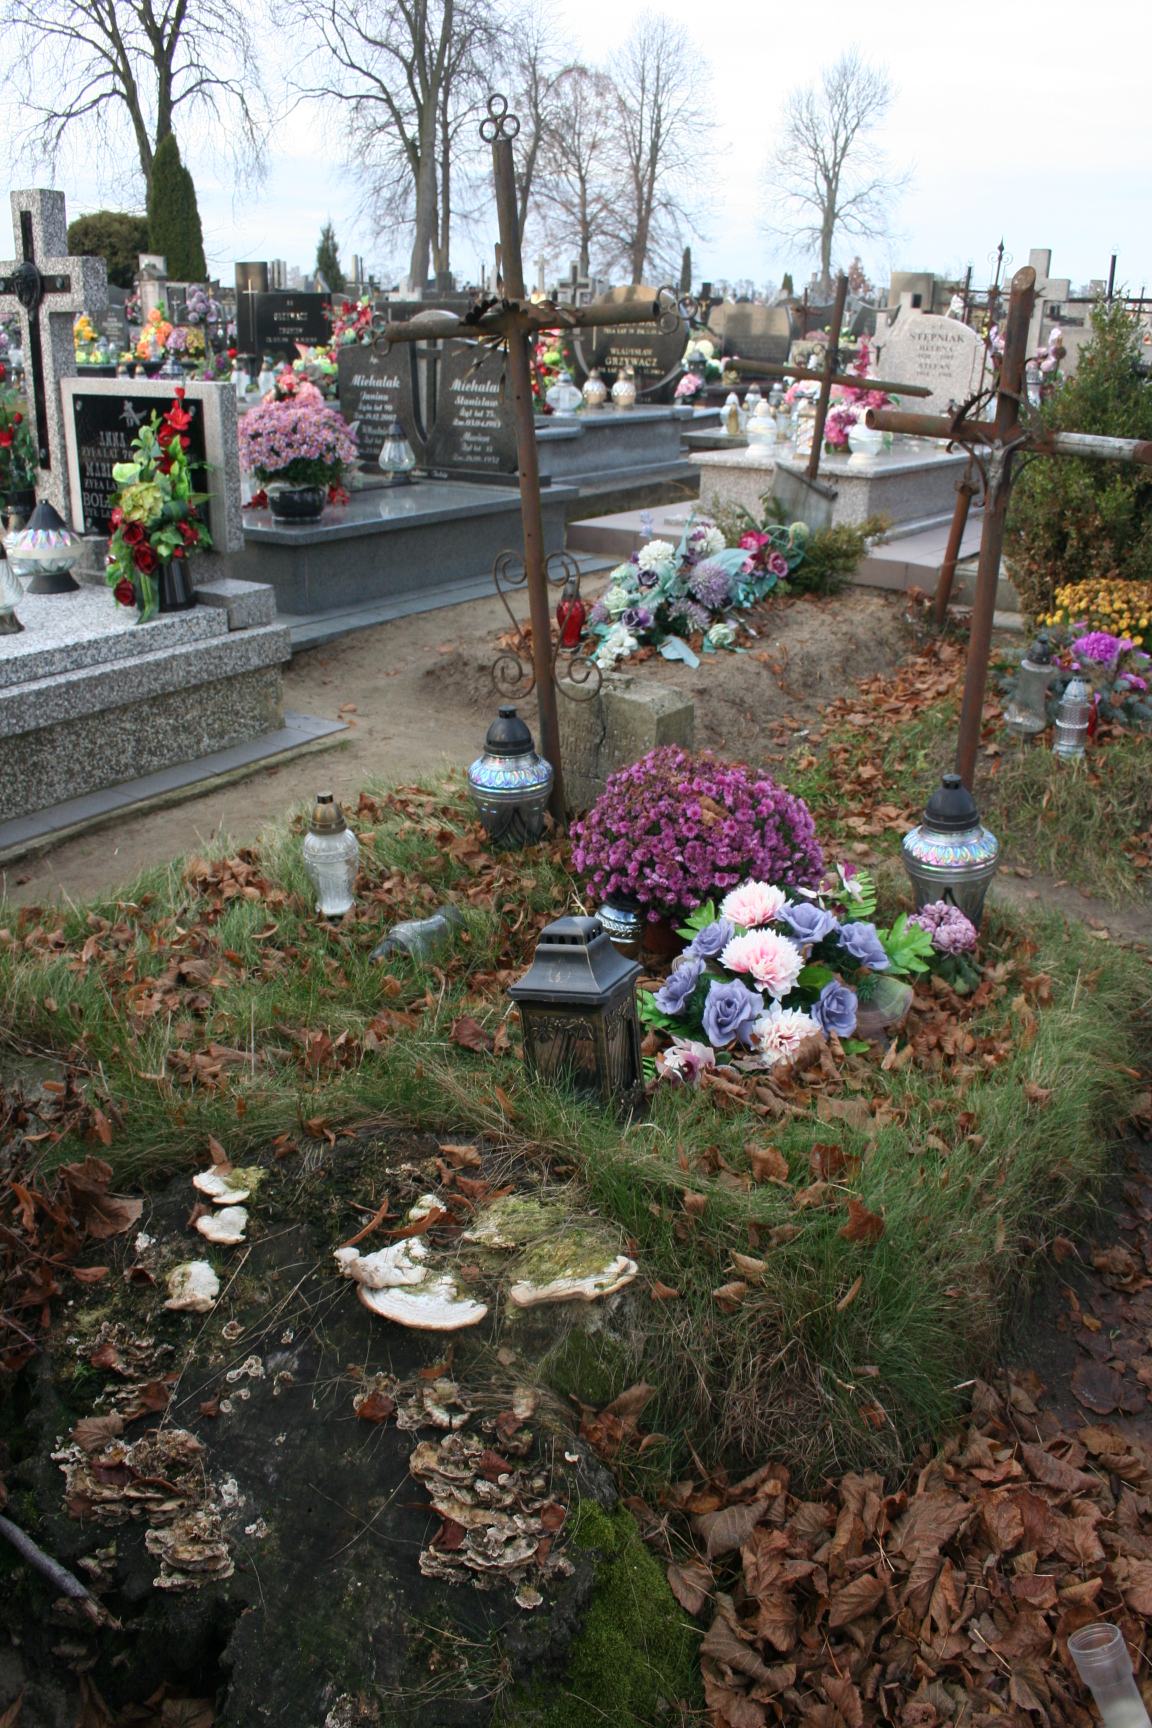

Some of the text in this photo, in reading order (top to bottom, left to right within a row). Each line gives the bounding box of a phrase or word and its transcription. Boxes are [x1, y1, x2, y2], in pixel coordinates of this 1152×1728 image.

[910, 334, 965, 343] STĘPNIAK
[605, 357, 658, 367] GRZYWACZ
[350, 375, 400, 388] Michalak
[449, 379, 500, 393] Michala
[361, 390, 389, 401] Janina
[455, 396, 499, 407] Stanisław
[99, 431, 126, 448] ANNA
